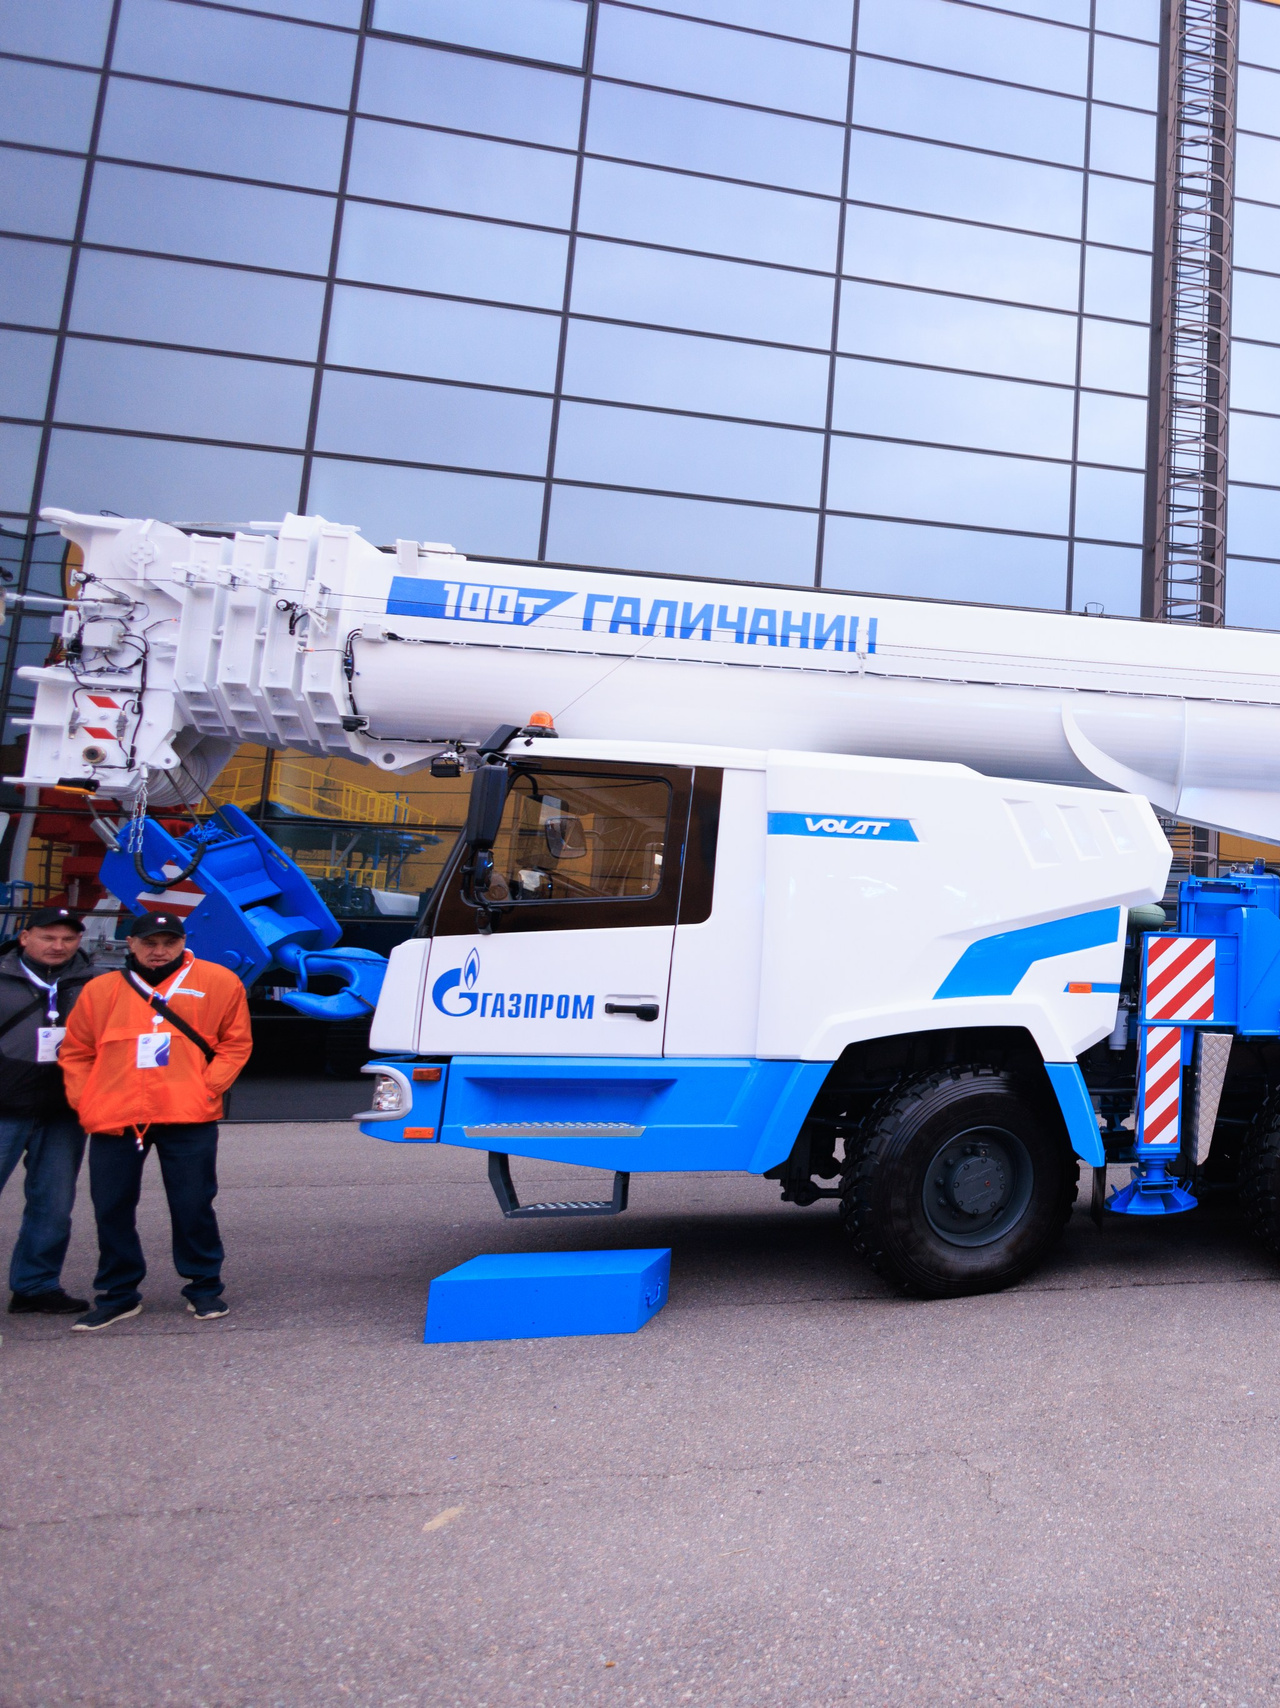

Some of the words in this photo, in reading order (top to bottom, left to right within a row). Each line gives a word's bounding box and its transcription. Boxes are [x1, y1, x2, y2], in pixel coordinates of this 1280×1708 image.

[582, 592, 878, 655] ГАЛИЧАНИН
[805, 817, 891, 836] VOLAT
[480, 992, 595, 1020] ГАЗПРОМ
